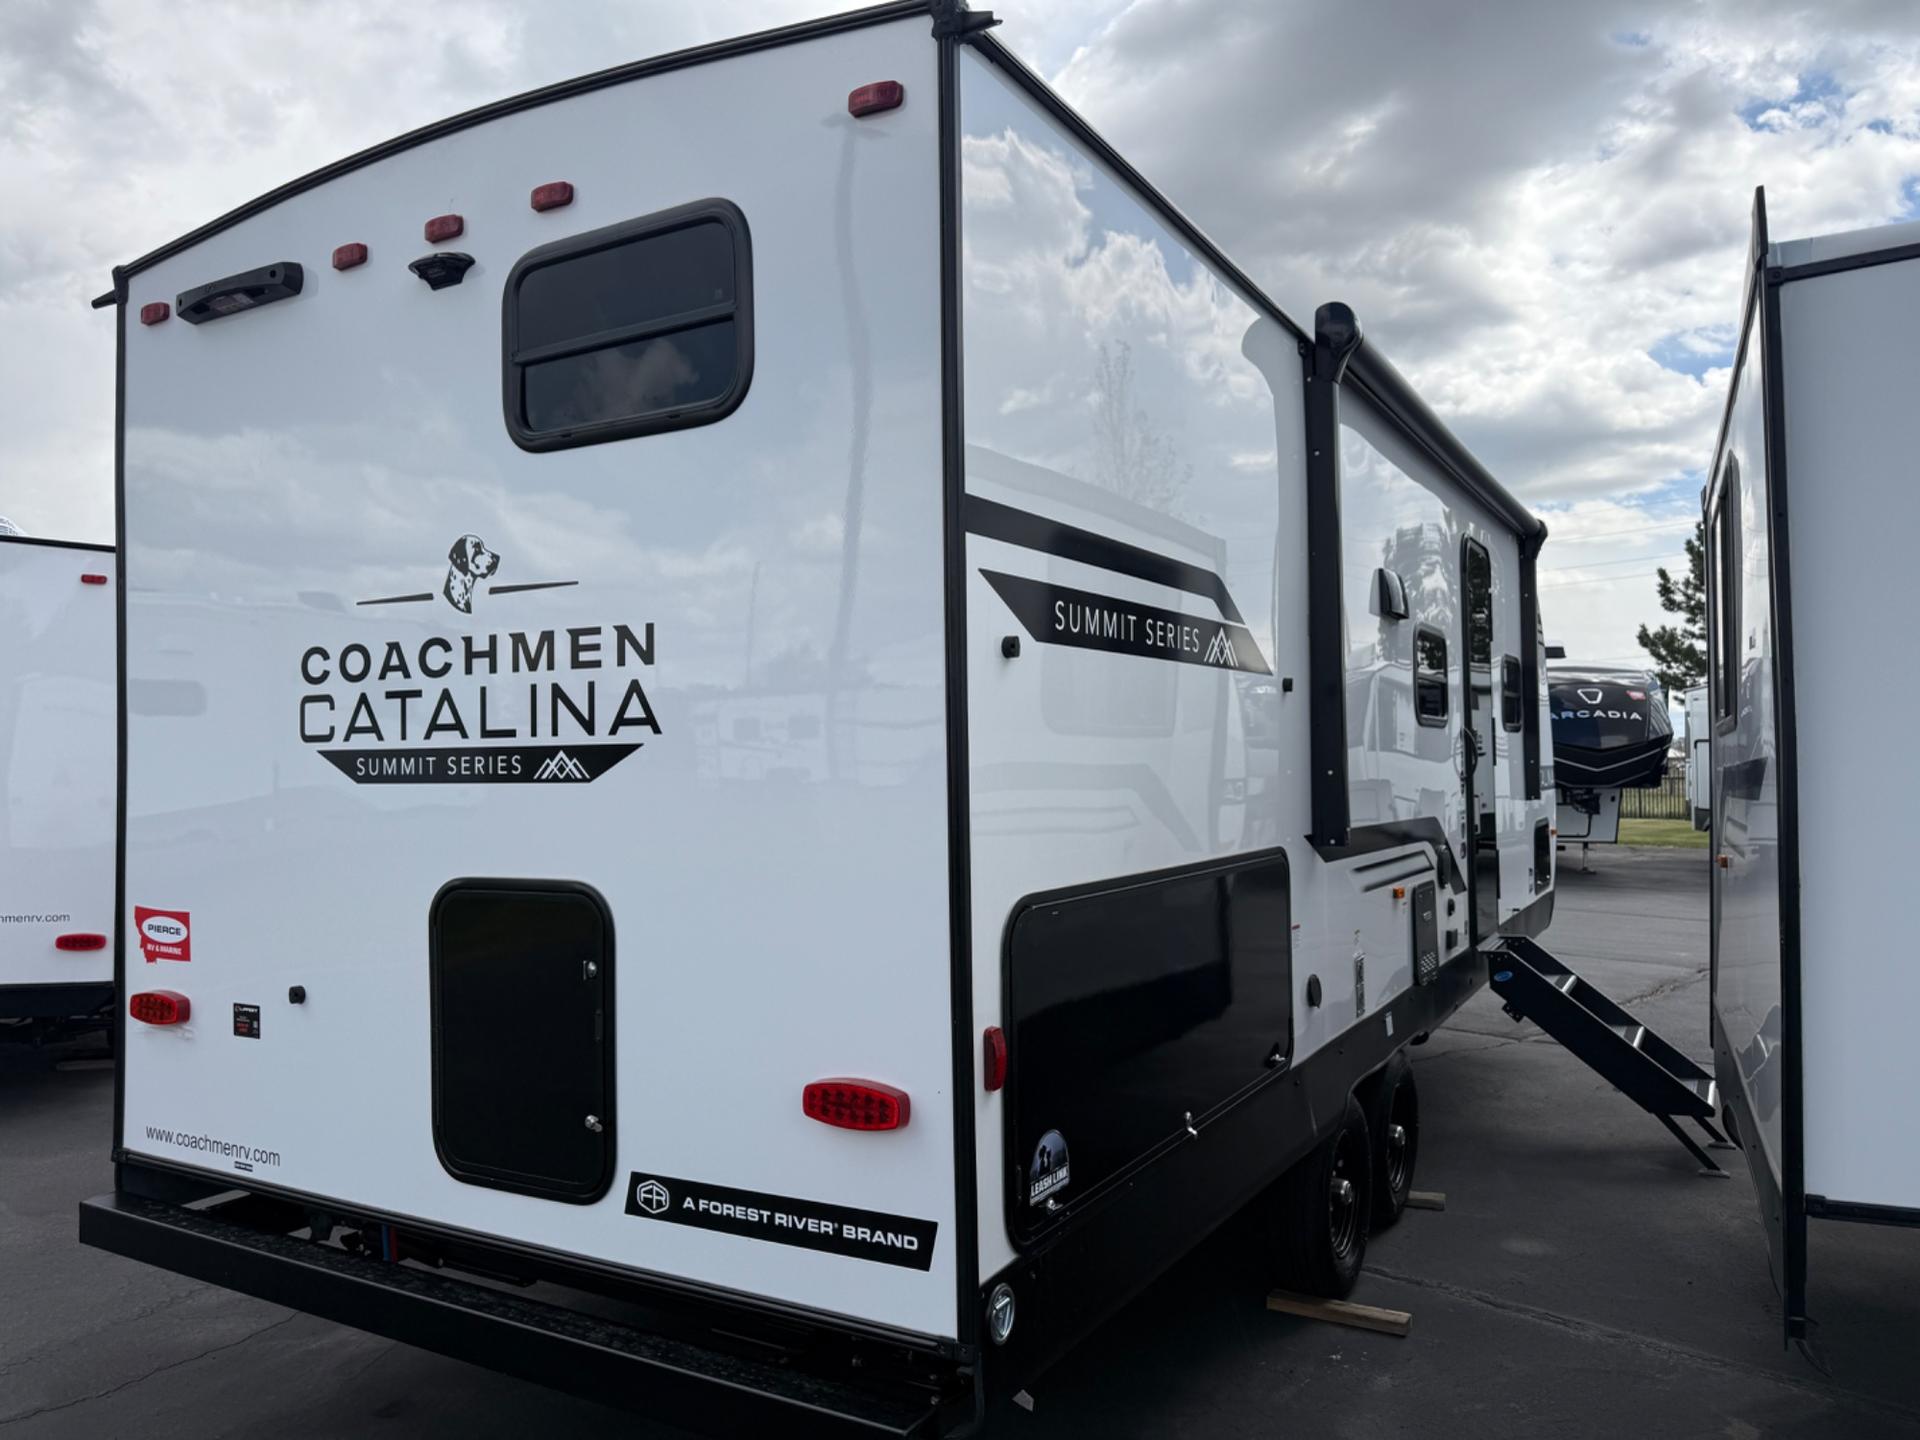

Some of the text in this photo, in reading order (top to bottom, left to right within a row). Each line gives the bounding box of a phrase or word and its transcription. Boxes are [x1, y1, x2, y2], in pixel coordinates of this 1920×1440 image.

[1054, 600, 1200, 653] SUMMIT SERIES
[301, 622, 655, 685] COACHMEN
[299, 678, 663, 743] CATALINA
[356, 755, 522, 776] SUMMIT SERIES
[147, 923, 181, 936] PIERCE
[146, 1125, 280, 1166] www.coachmenrv.com
[682, 1197, 696, 1210] A
[699, 1199, 772, 1224] FOREST
[843, 1224, 918, 1251] BRAND
